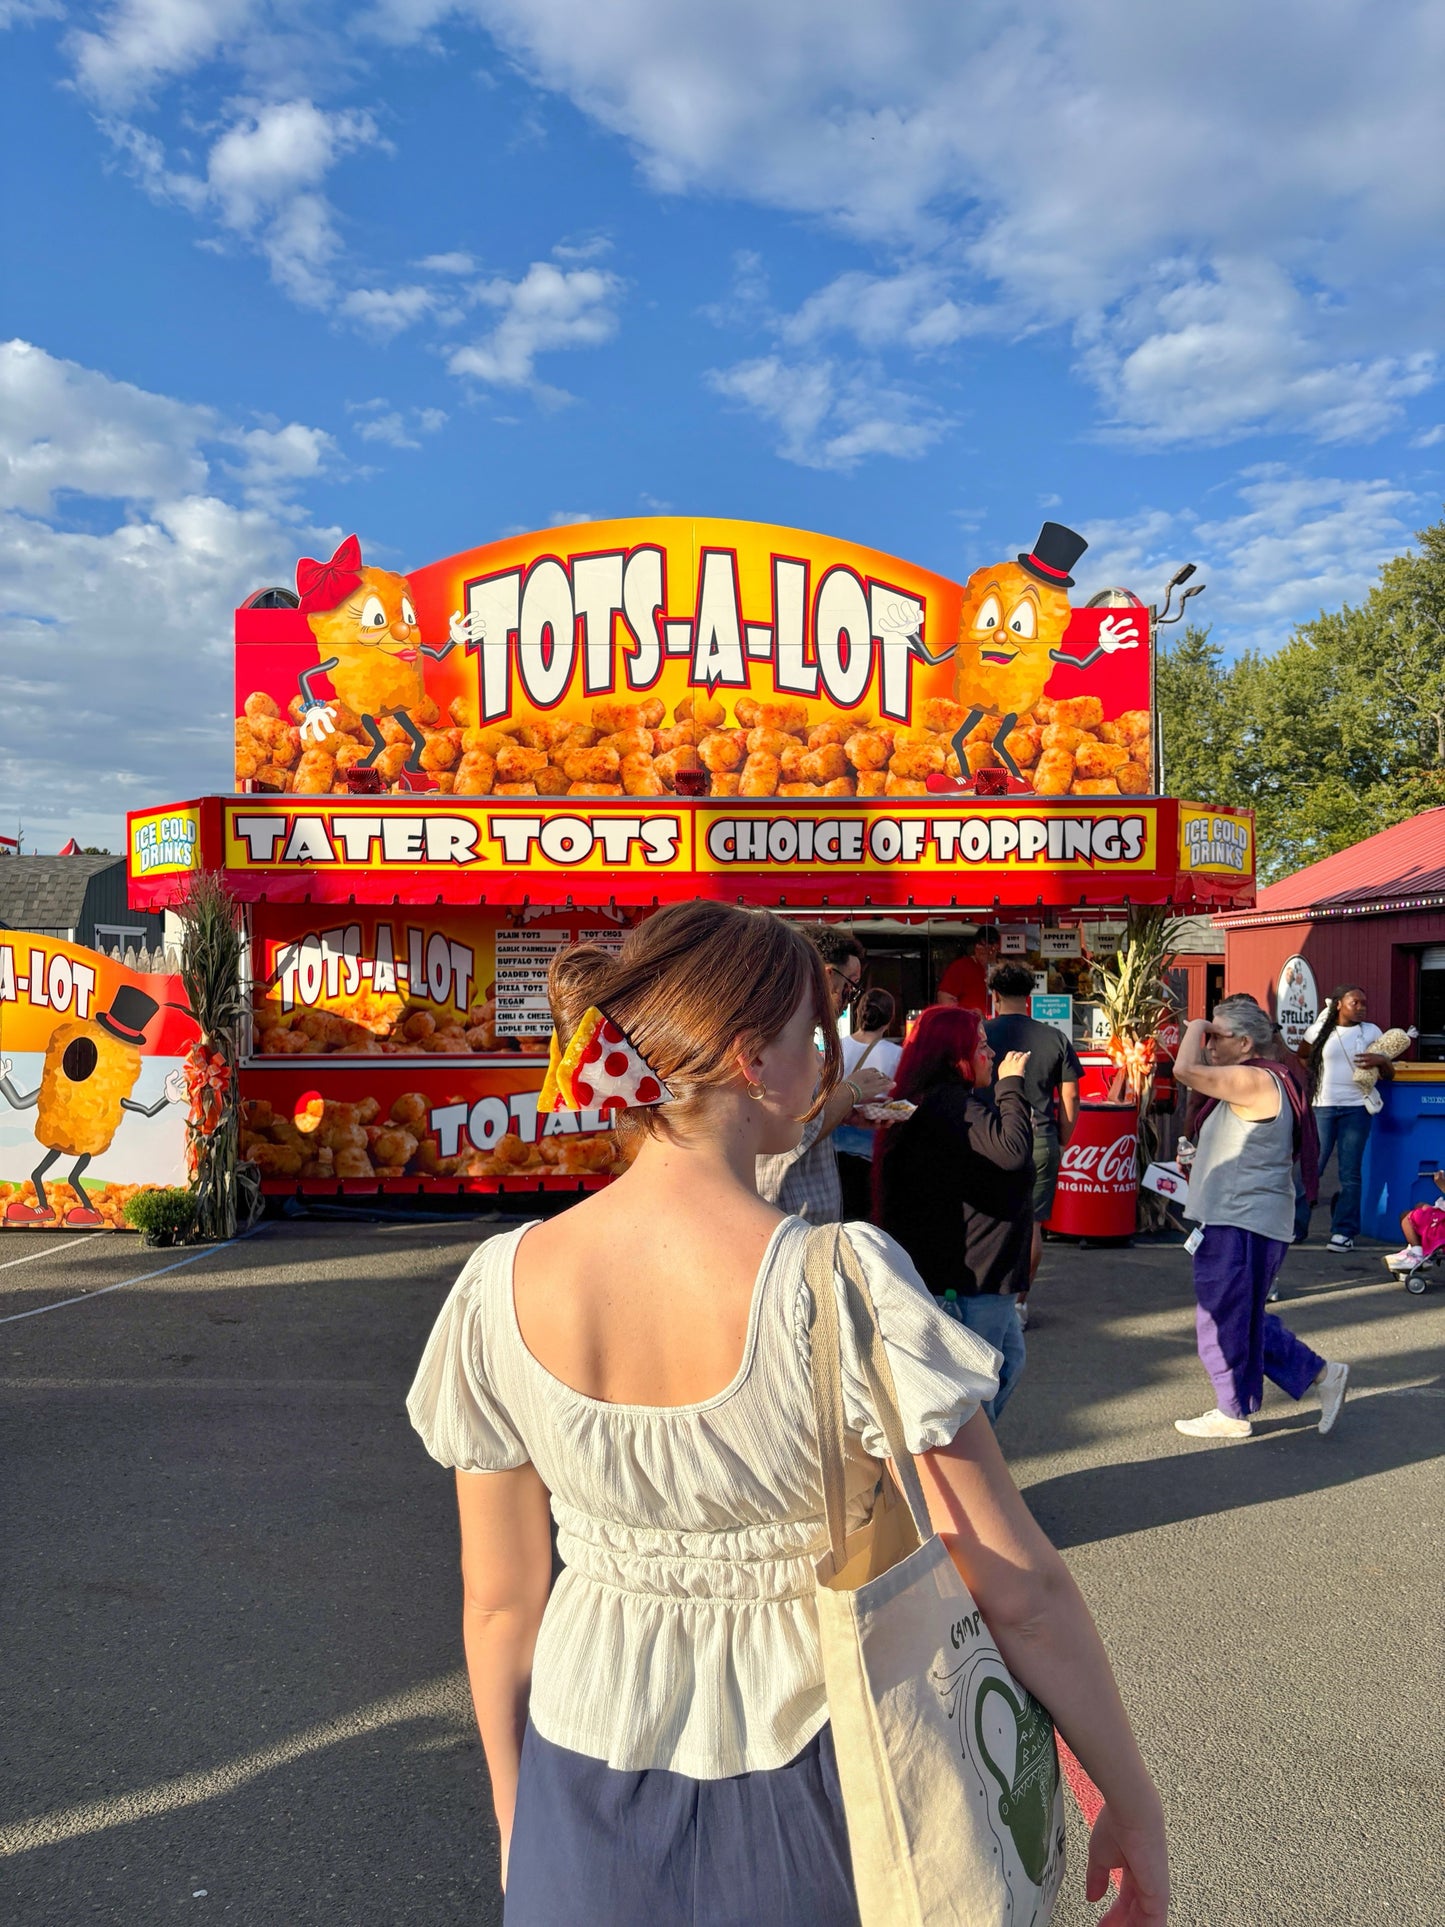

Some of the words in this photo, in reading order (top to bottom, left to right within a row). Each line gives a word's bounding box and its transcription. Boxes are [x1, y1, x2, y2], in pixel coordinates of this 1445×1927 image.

[466, 545, 926, 725] TOTS-A-LOT
[135, 822, 157, 854] ICE
[161, 817, 196, 844] COLD
[235, 815, 483, 865] TATER
[490, 815, 680, 864] TOTS
[708, 817, 865, 862] CHOICE
[869, 817, 927, 862] OF
[931, 817, 1146, 867] TOPPINGS
[1185, 818, 1209, 847] ICE
[1213, 818, 1248, 850] COLD
[1190, 841, 1243, 871] DRINKS
[141, 841, 192, 873] DRINKS
[276, 924, 474, 1014] TOTS-A-LOT
[431, 1091, 616, 1158] TOTAL
[951, 1611, 984, 1649] CAMP
